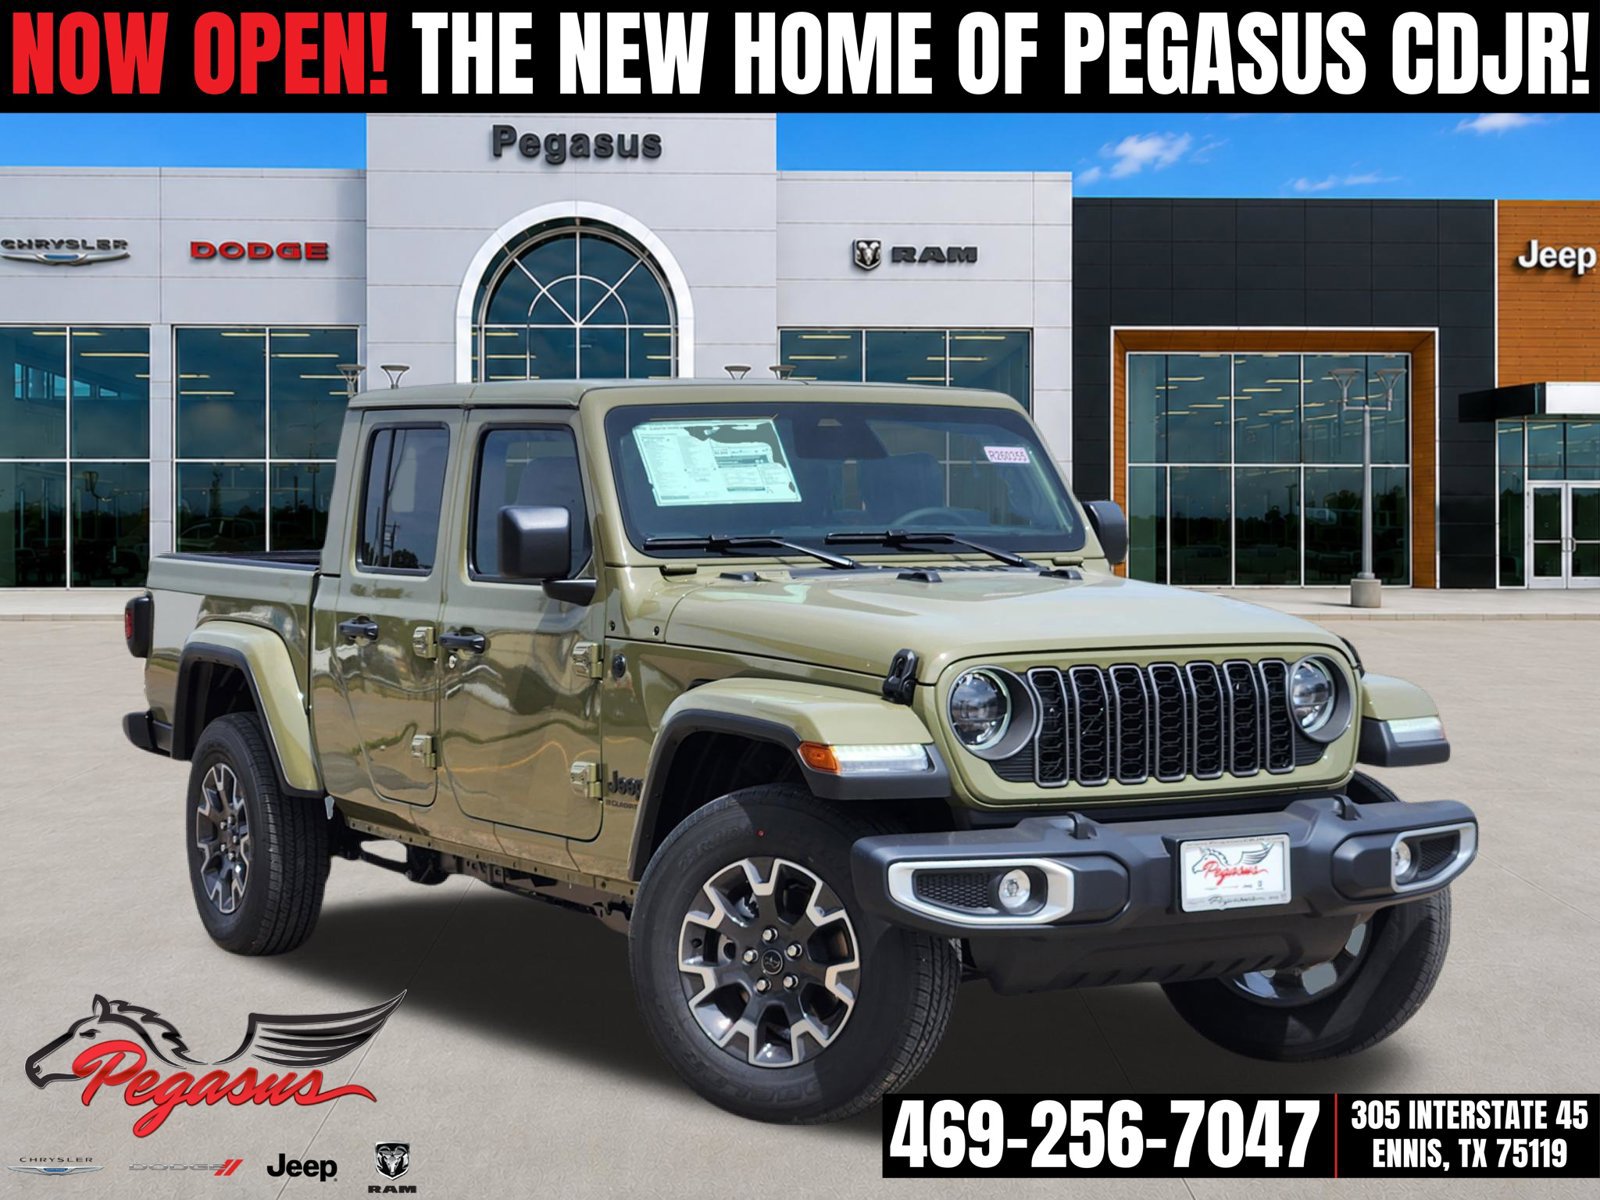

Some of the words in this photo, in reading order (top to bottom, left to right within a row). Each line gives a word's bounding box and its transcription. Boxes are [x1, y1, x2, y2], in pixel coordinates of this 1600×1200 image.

[492, 124, 662, 165] Pegasus
[0, 239, 129, 250] CHRYSLER
[191, 241, 329, 261] DODGE
[891, 246, 978, 263] RAM
[1517, 239, 1597, 275] Jeep
